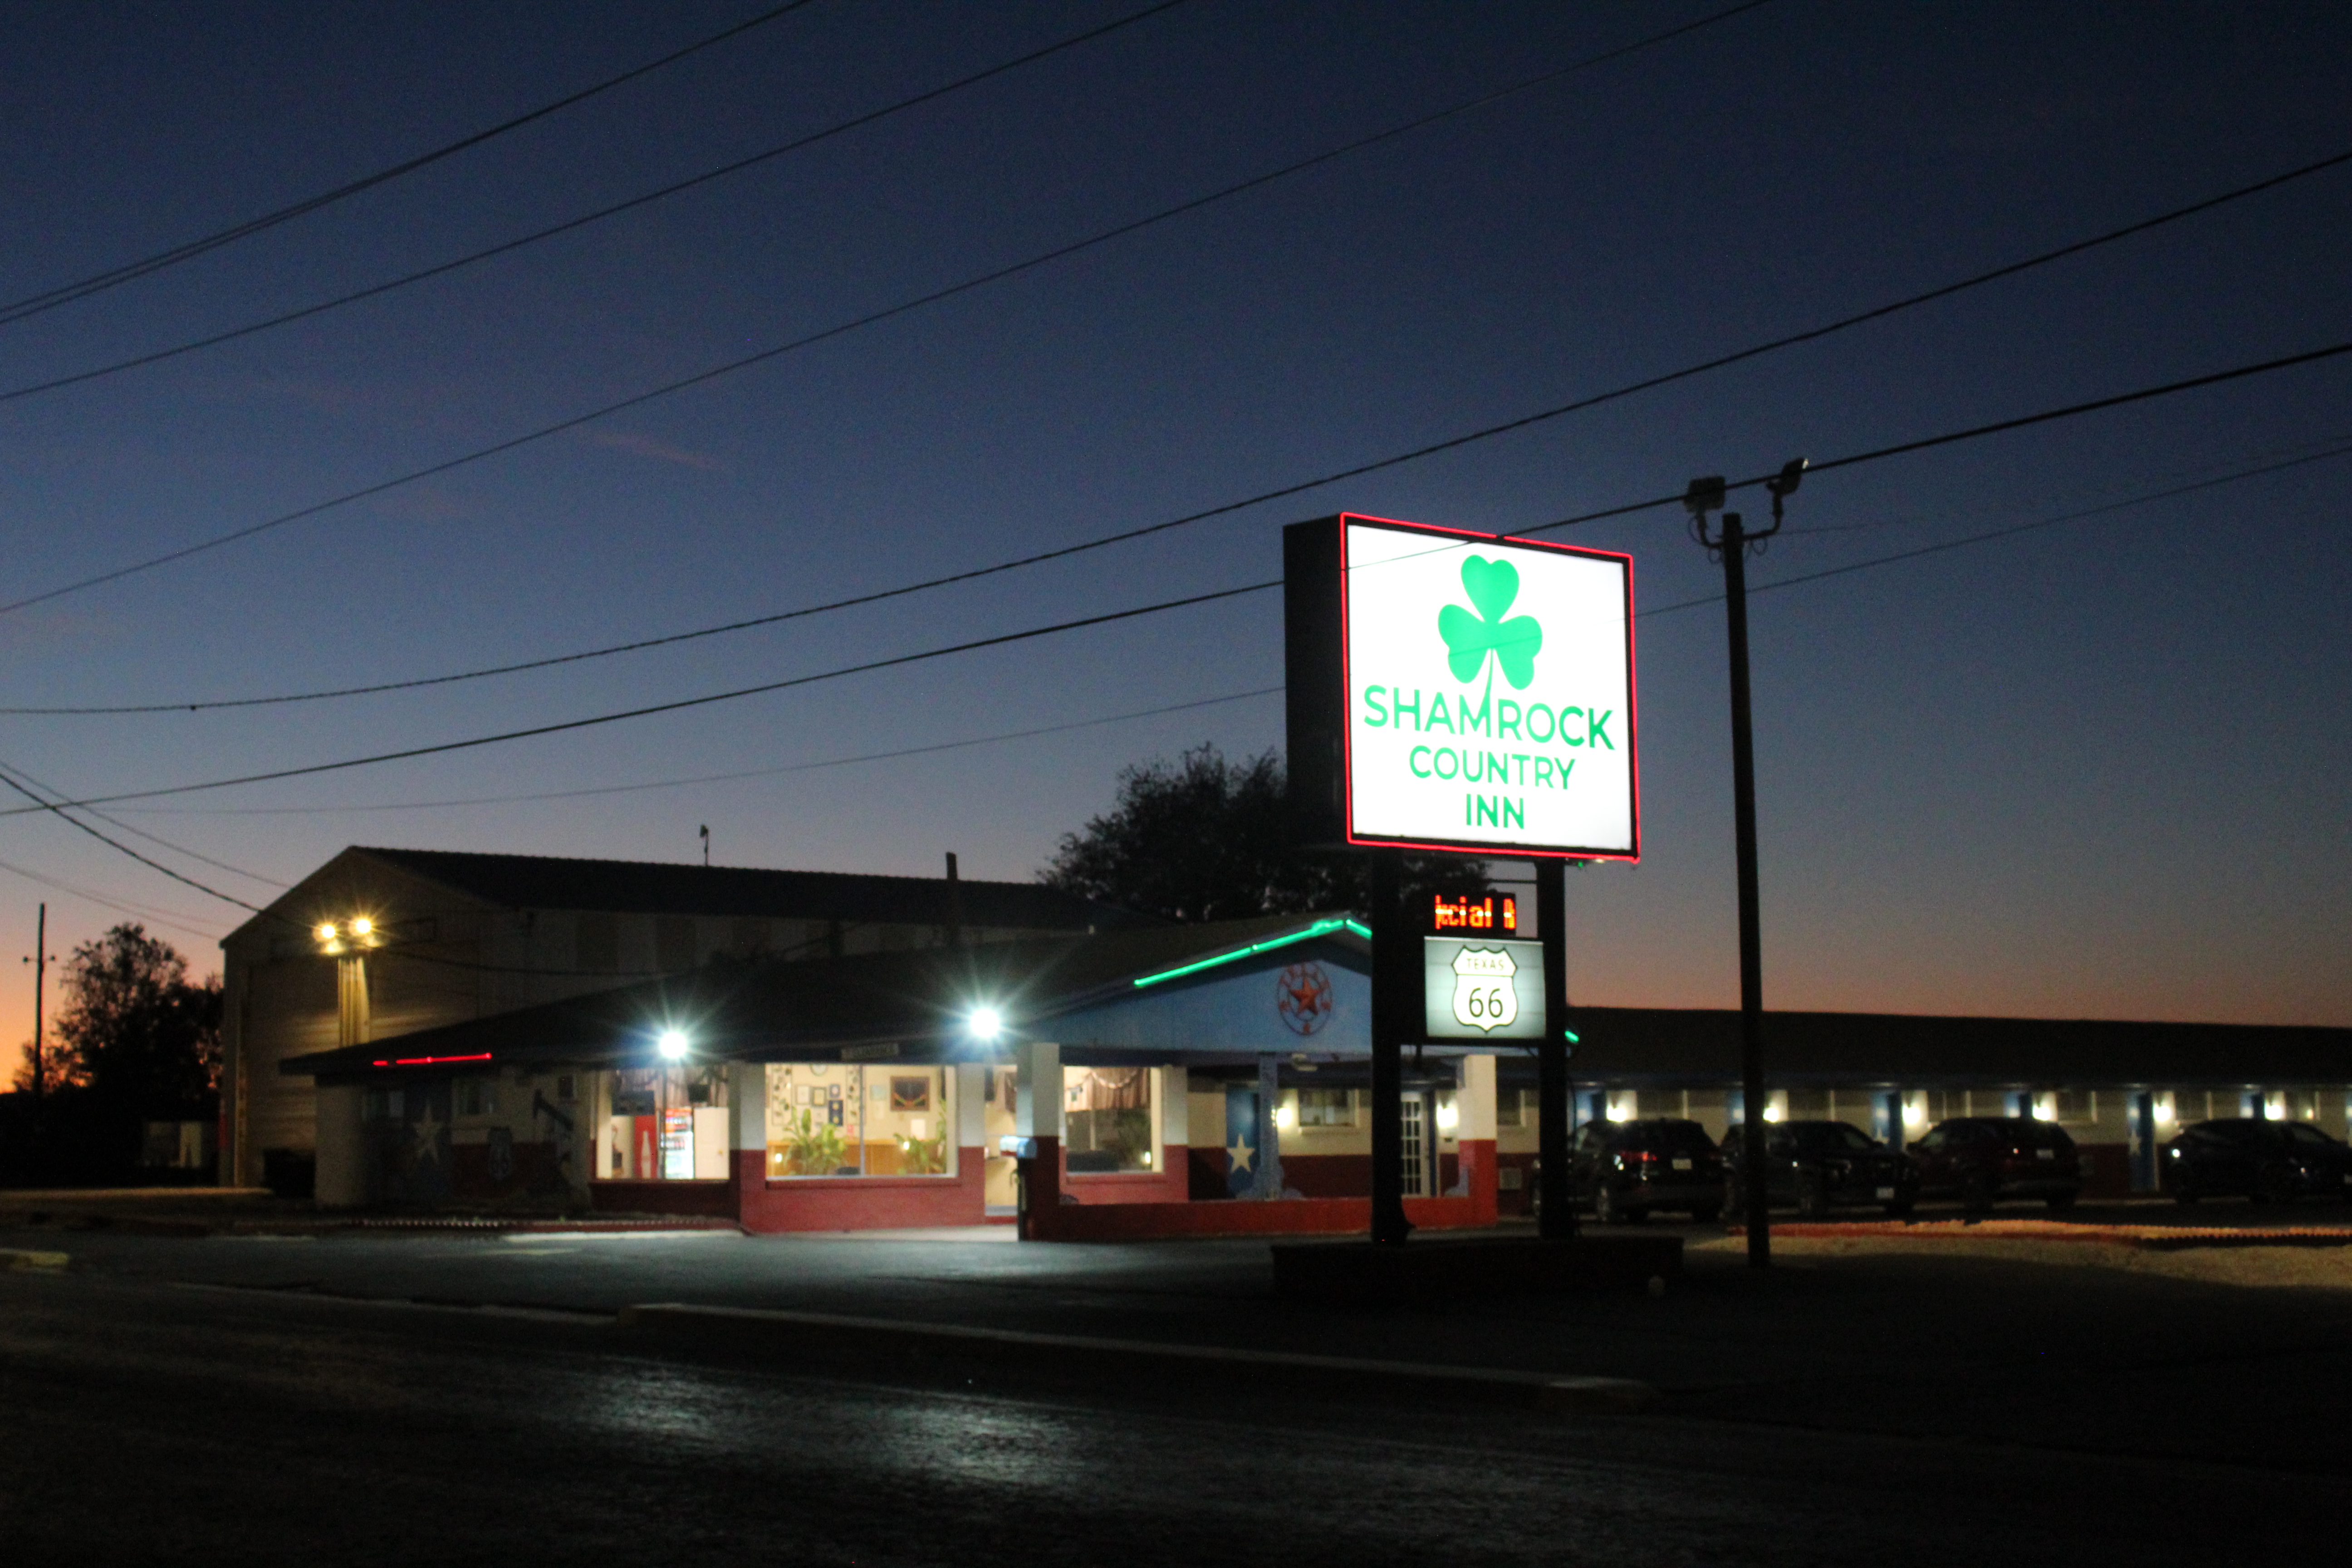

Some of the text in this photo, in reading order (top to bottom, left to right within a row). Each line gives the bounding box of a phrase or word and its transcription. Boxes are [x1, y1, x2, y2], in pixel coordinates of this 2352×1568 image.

[1363, 685, 1615, 750] SHAMROCK
[1409, 745, 1576, 789] COUNTRY
[1466, 794, 1525, 830] INN
[1466, 958, 1504, 970] TEXAS
[1469, 987, 1503, 1018] 66
